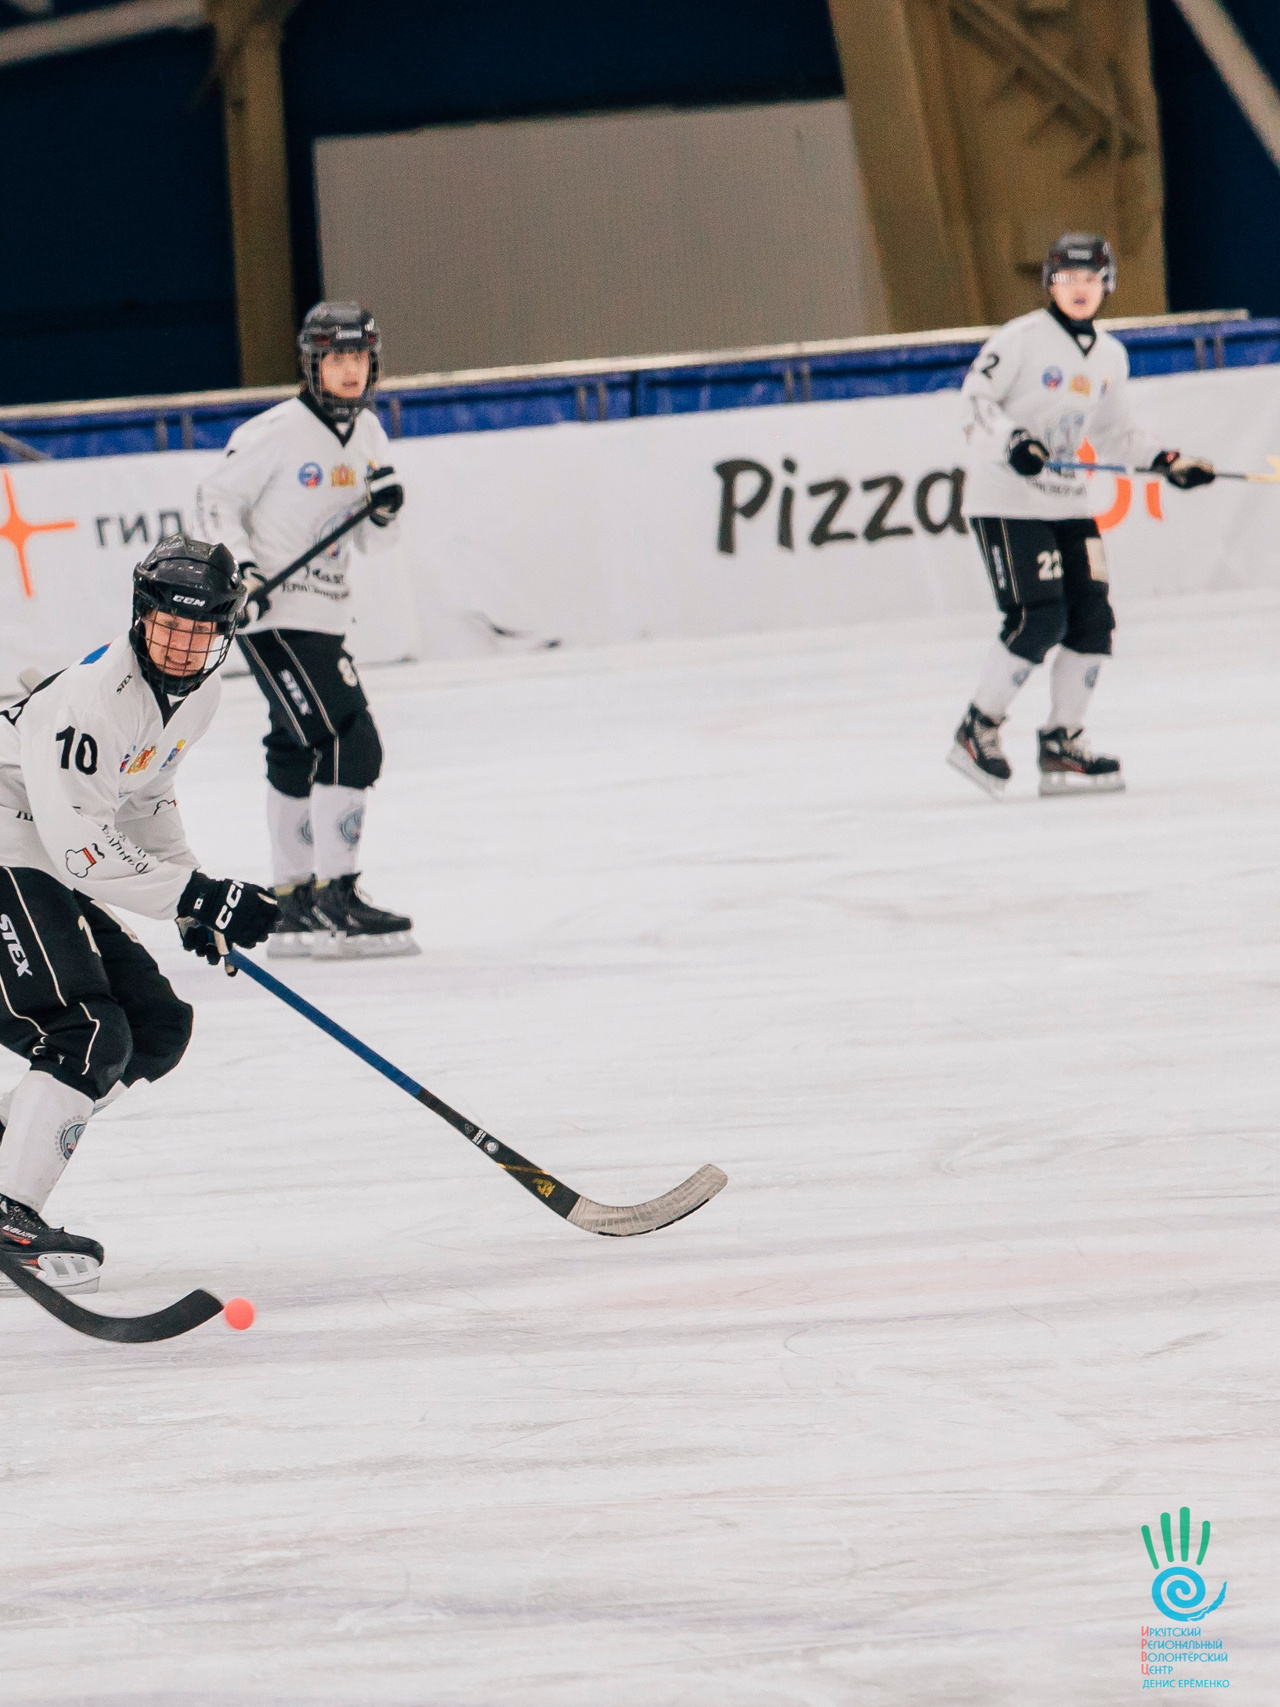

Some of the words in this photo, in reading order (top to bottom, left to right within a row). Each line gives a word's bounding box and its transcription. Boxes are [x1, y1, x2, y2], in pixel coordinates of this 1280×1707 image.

[980, 353, 1001, 381] 2
[714, 454, 969, 555] Pizza
[95, 509, 183, 546] гид
[173, 594, 205, 607] CCM
[55, 725, 98, 775] 10
